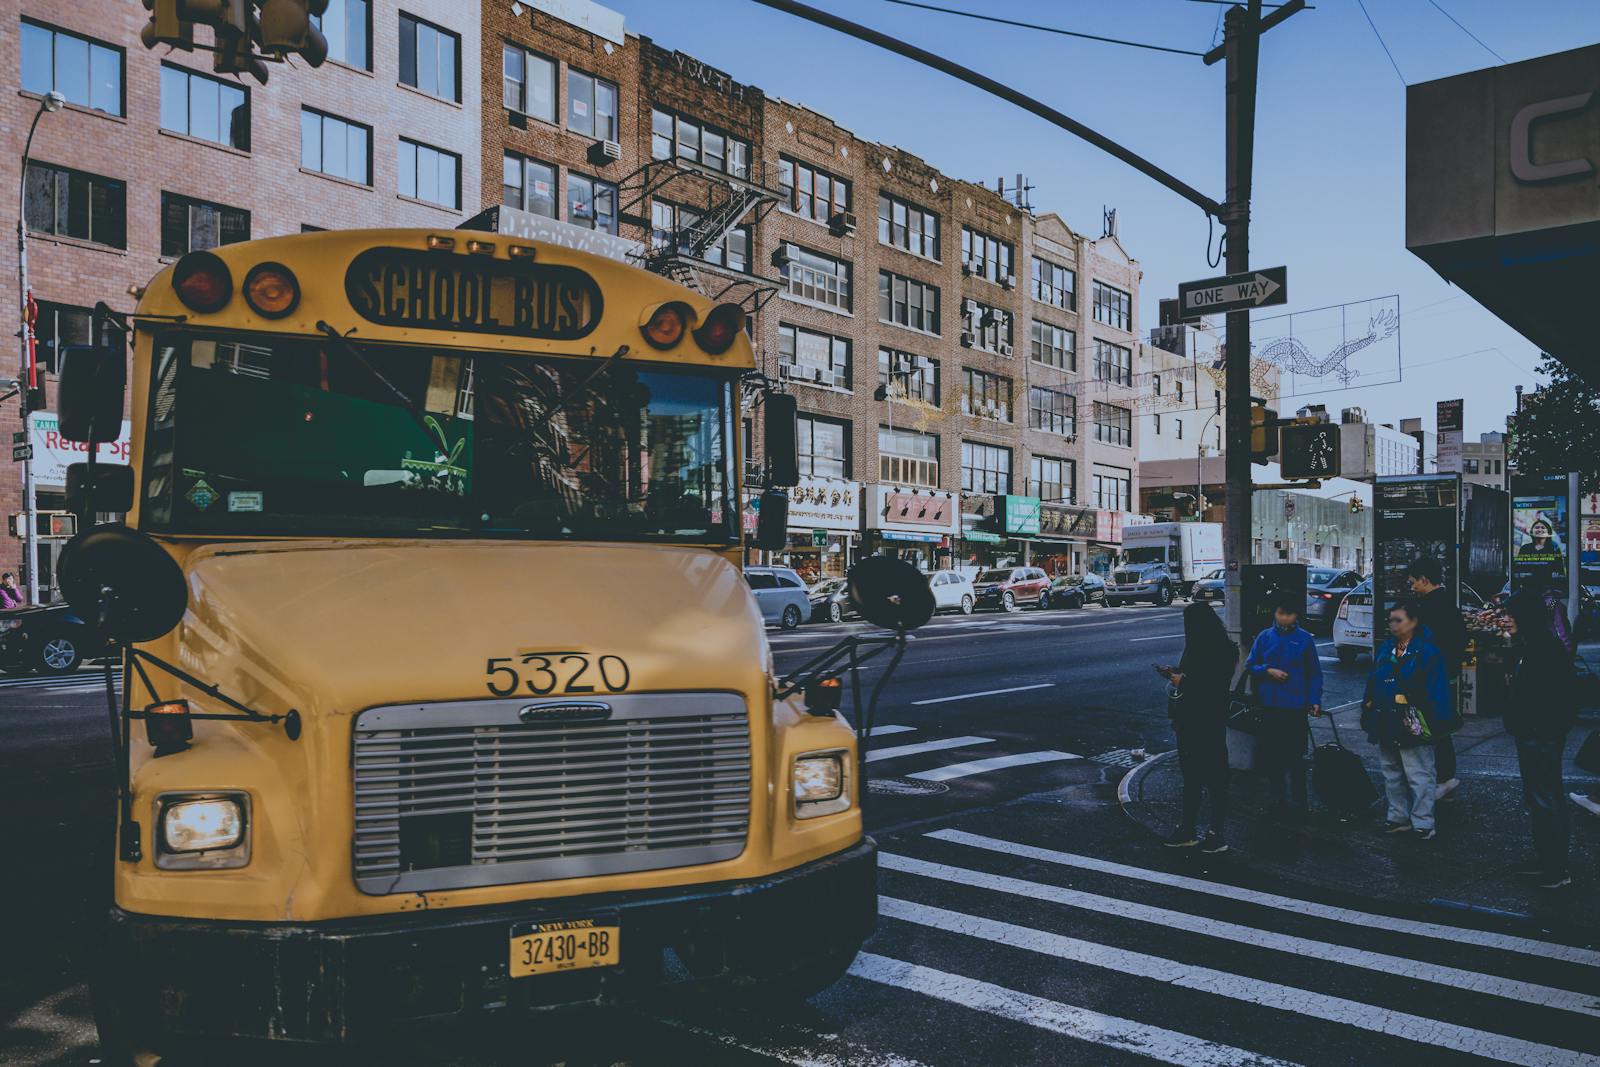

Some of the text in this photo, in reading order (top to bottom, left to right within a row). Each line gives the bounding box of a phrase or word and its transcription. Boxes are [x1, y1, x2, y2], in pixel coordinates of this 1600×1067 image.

[360, 265, 584, 334] SCHOOL BUS
[1194, 280, 1269, 305] ONE WAY
[486, 654, 630, 697] 5320
[538, 919, 594, 933] NEW YORK
